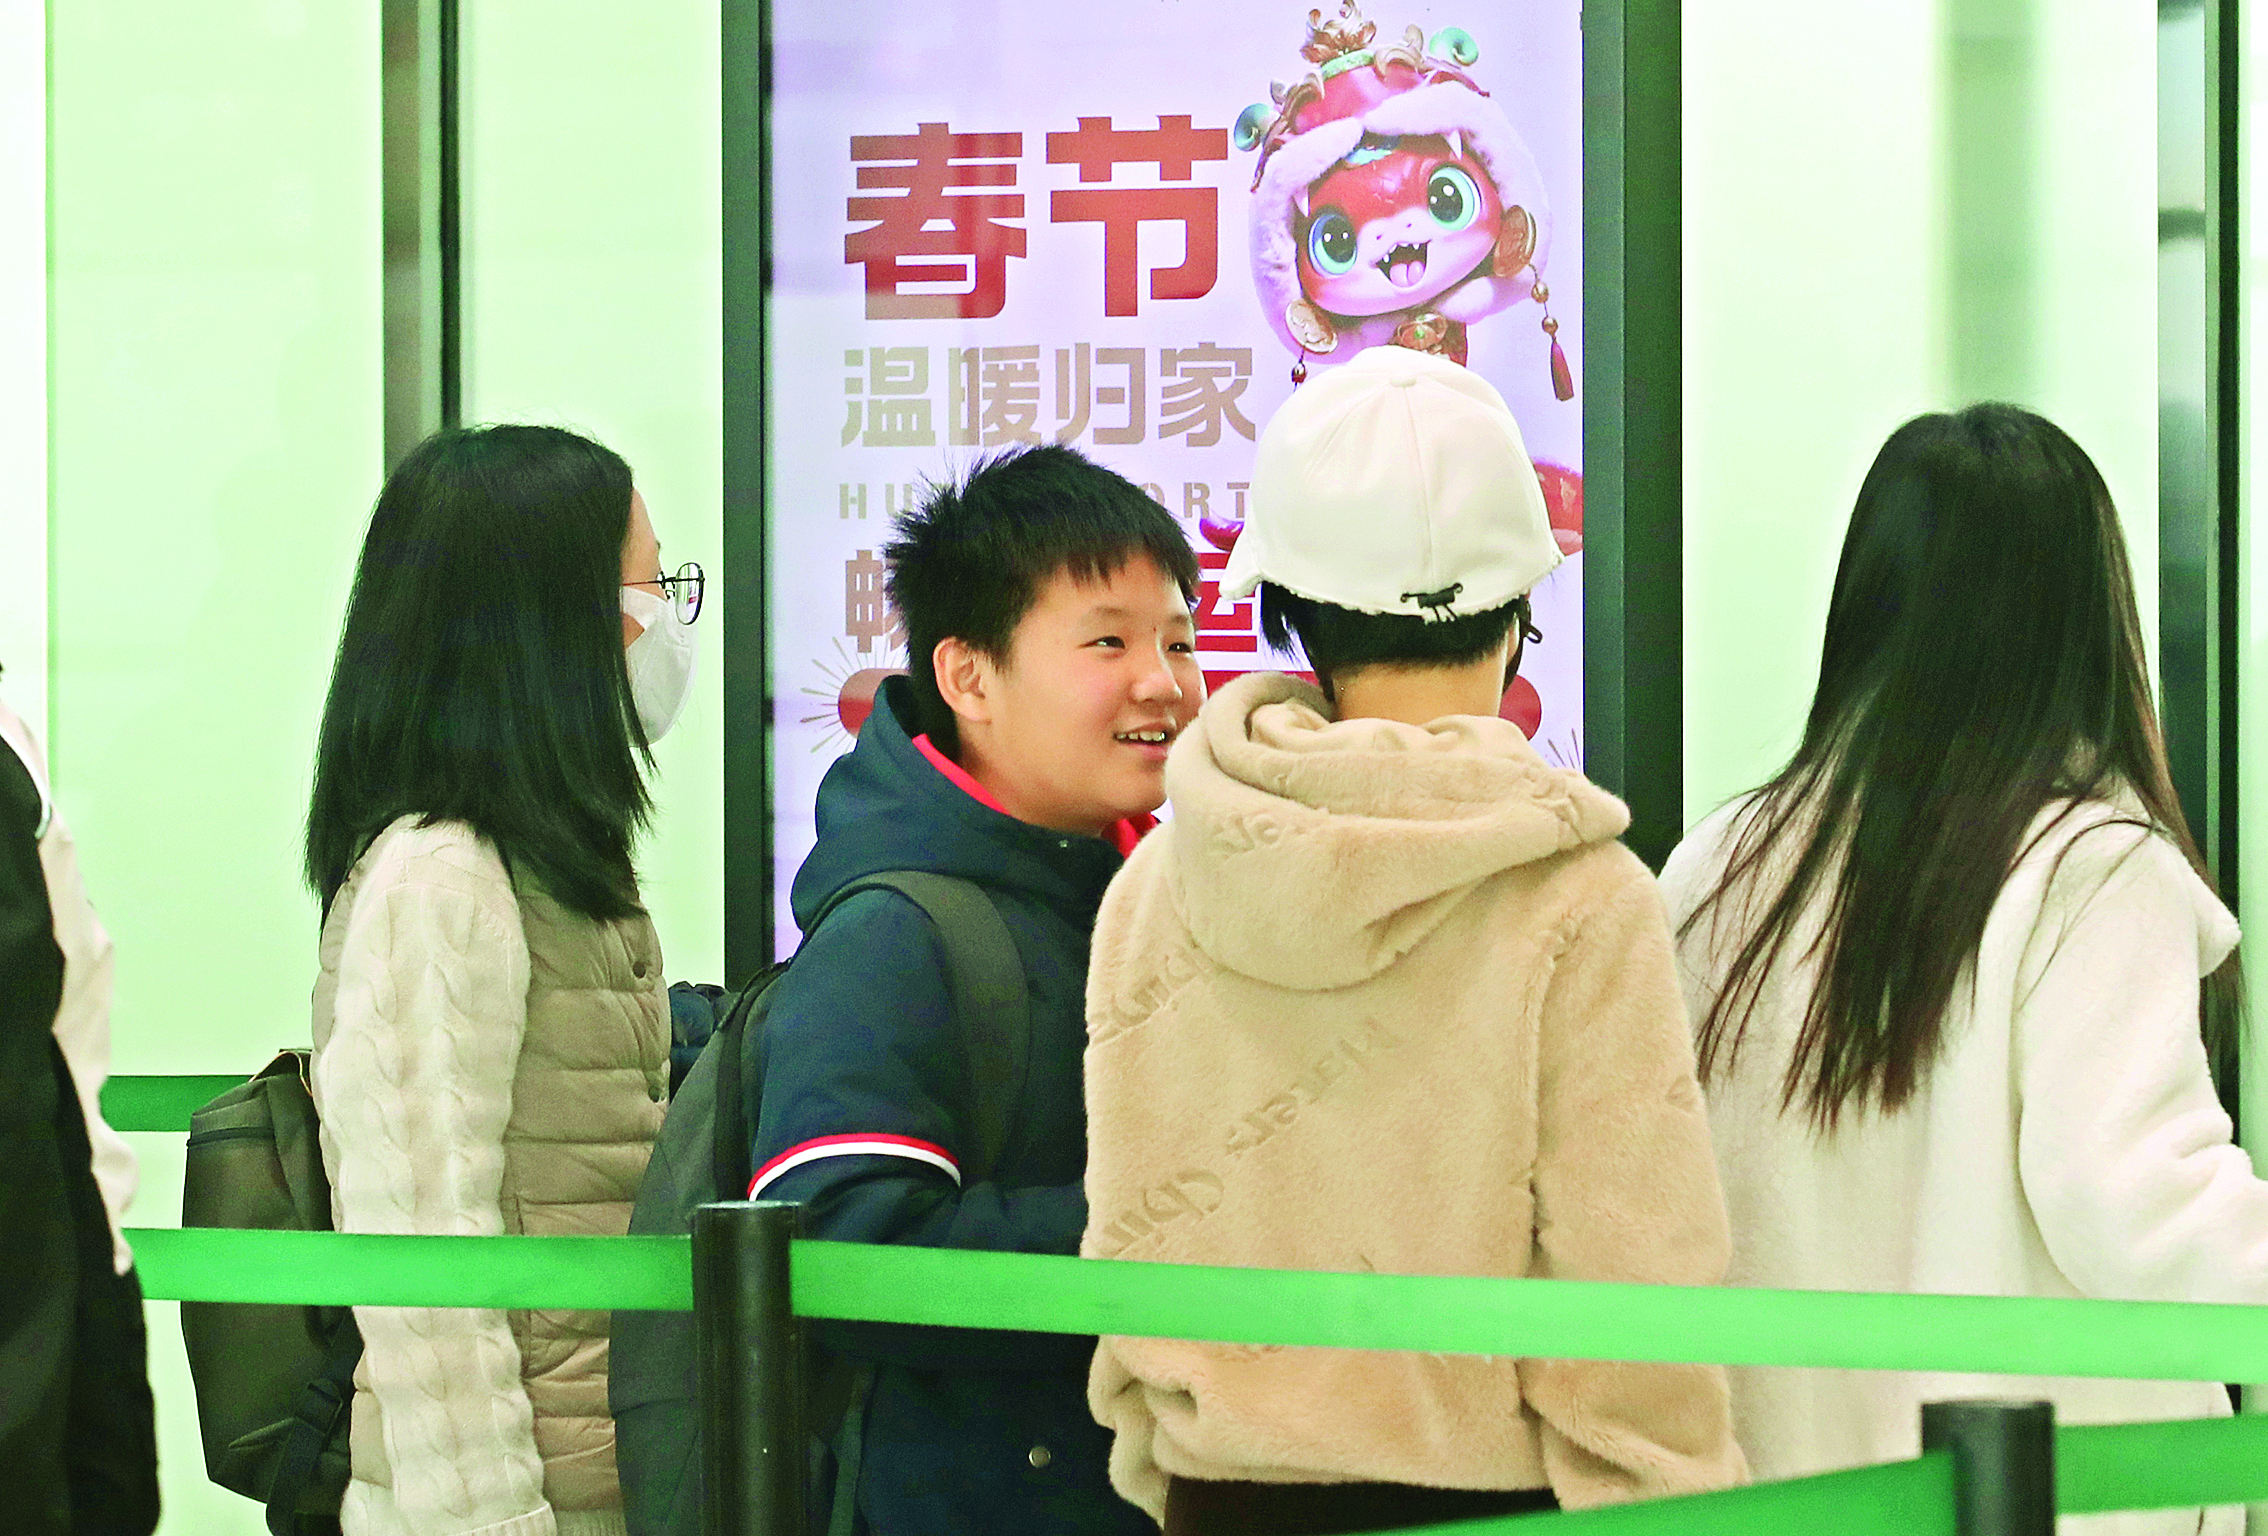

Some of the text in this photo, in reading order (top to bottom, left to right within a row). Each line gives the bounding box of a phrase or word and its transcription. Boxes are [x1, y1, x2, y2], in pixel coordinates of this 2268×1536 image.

[845, 115, 1228, 319] 春节
[841, 342, 1256, 448] 温暖归家
